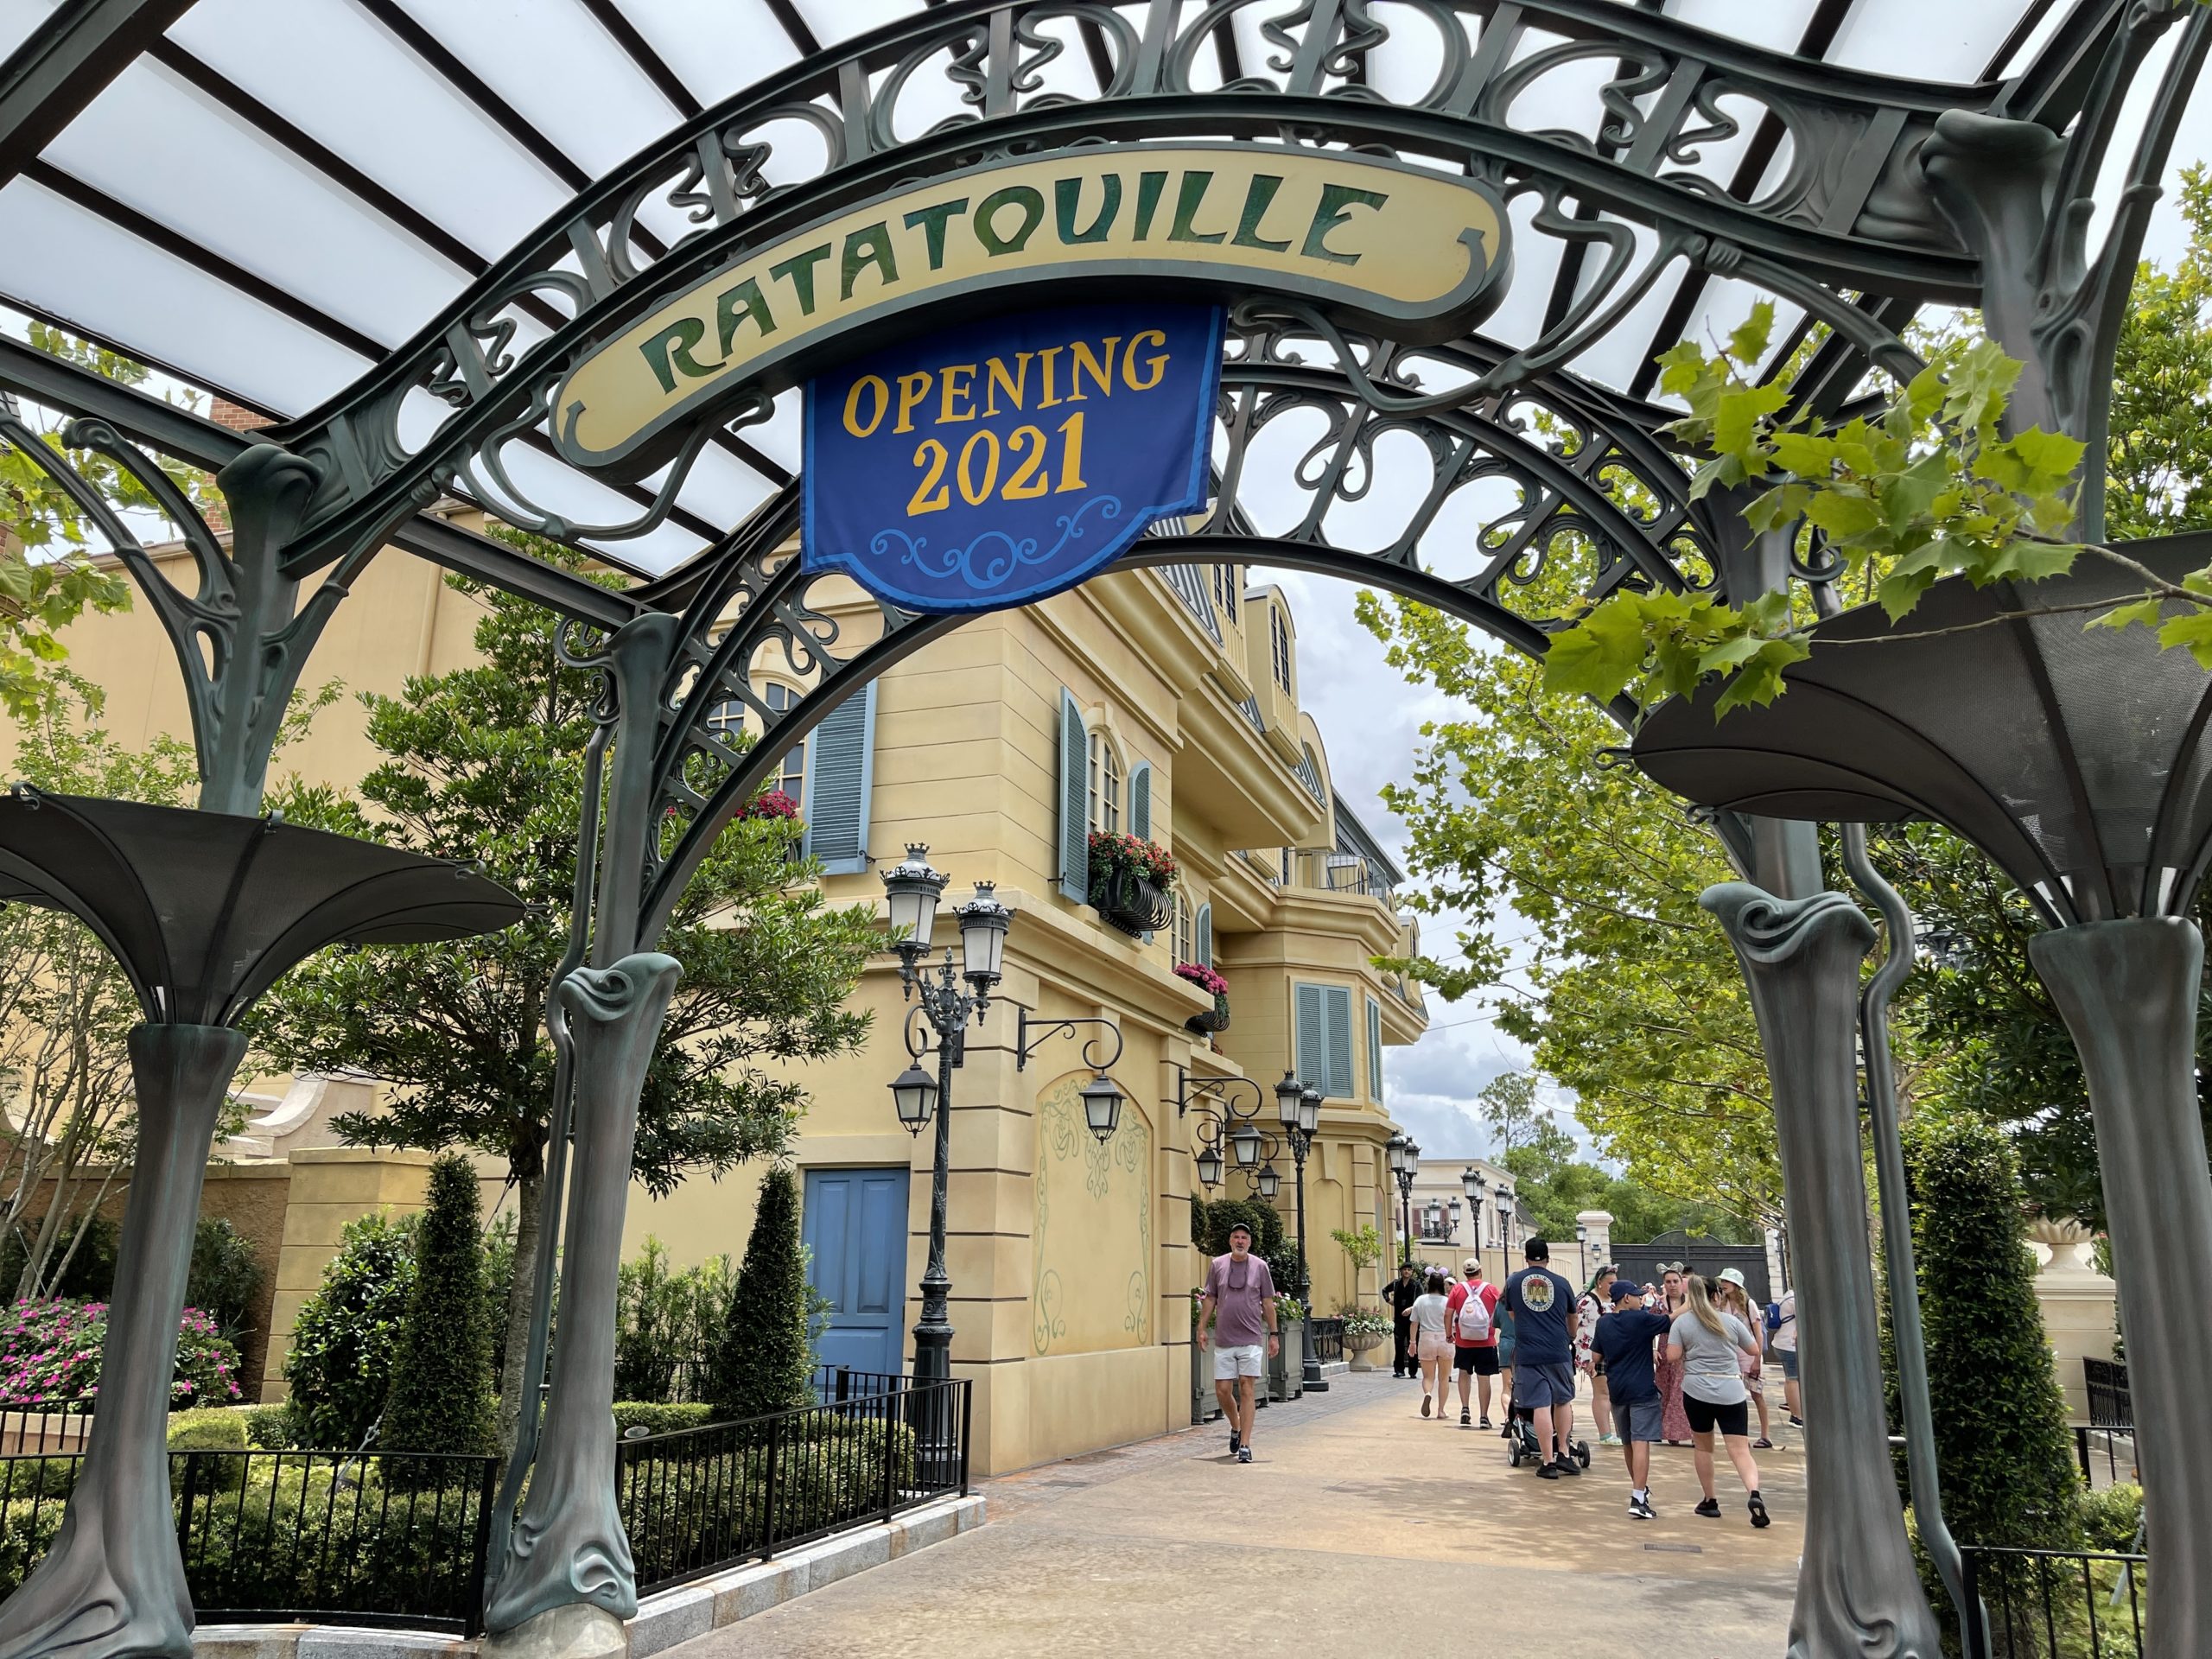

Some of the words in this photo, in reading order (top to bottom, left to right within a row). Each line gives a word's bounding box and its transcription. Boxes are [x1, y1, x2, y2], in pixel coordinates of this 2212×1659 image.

[639, 169, 1389, 395] RATATOUILLE
[842, 329, 1171, 438] OPENING
[906, 410, 1087, 517] 2021
